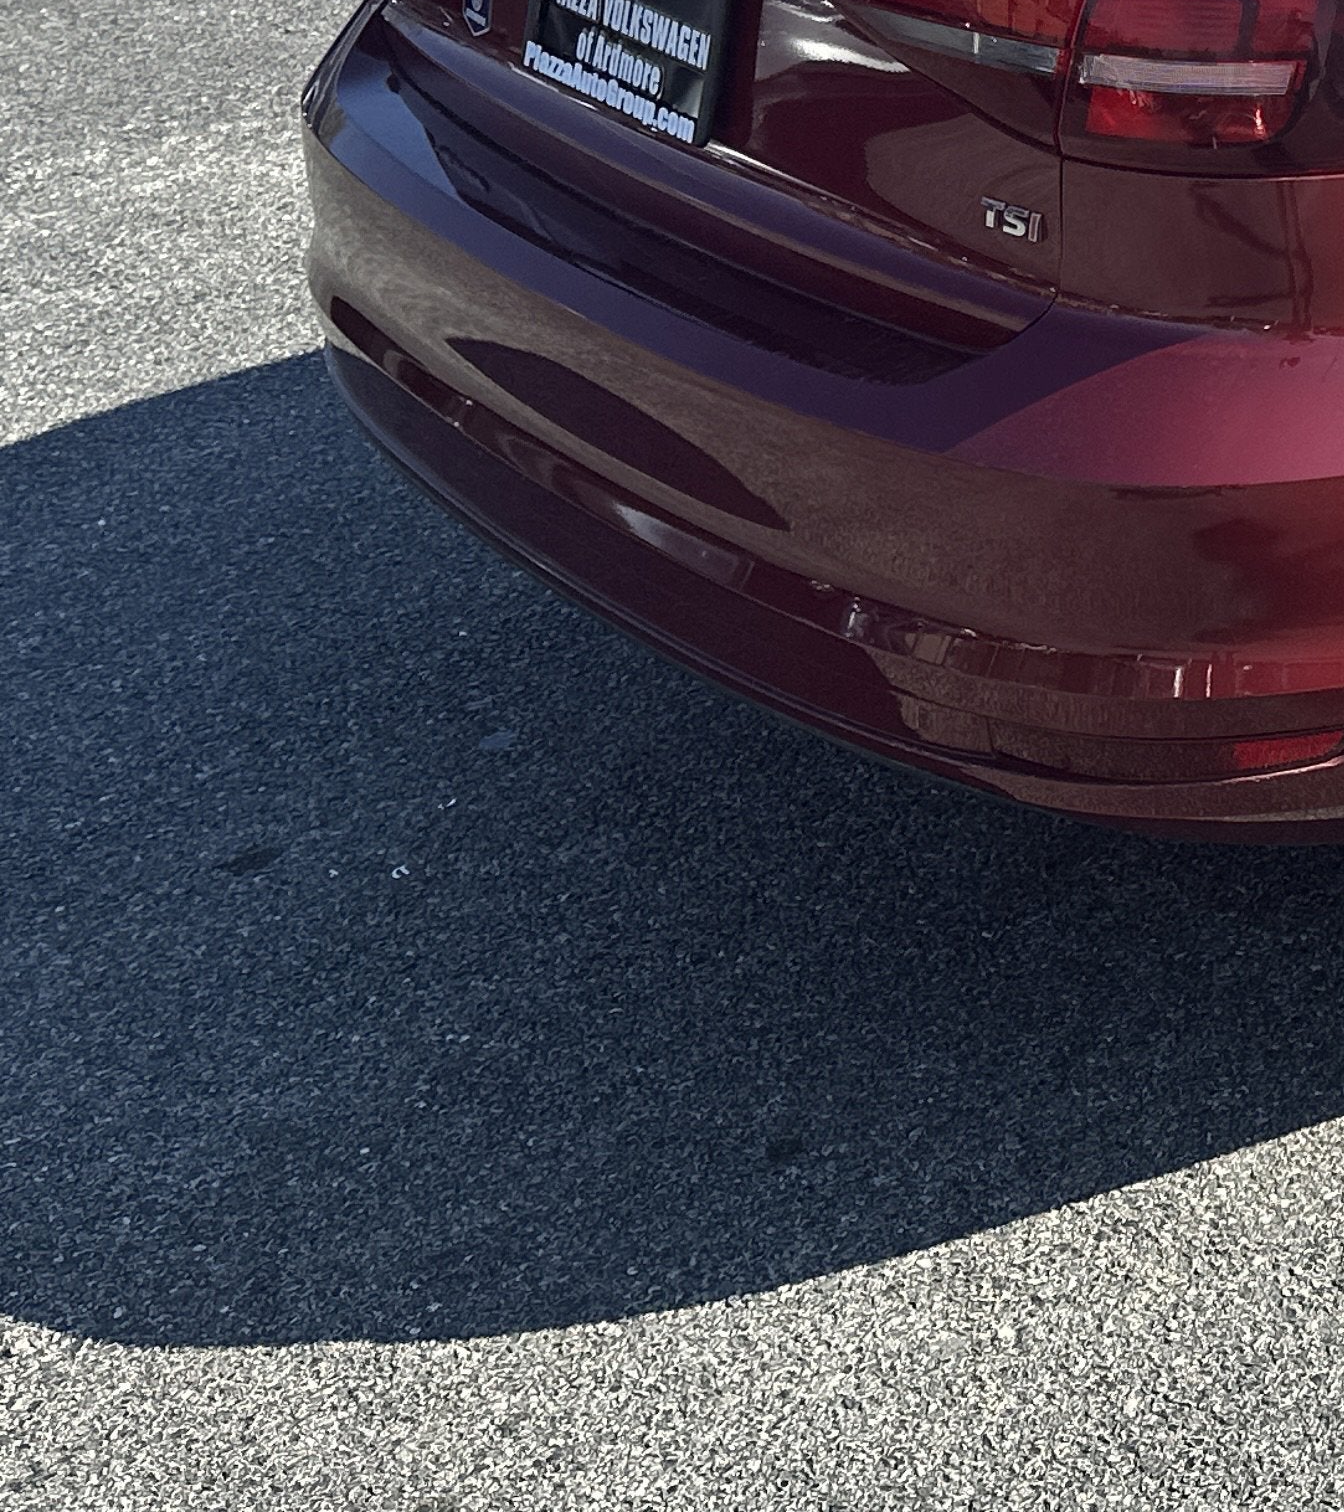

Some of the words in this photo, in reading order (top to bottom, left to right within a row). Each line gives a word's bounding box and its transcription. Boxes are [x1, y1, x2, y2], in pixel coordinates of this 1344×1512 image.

[576, 29, 597, 64] of
[591, 34, 662, 97] Ardmore
[980, 195, 1042, 244] TSI
